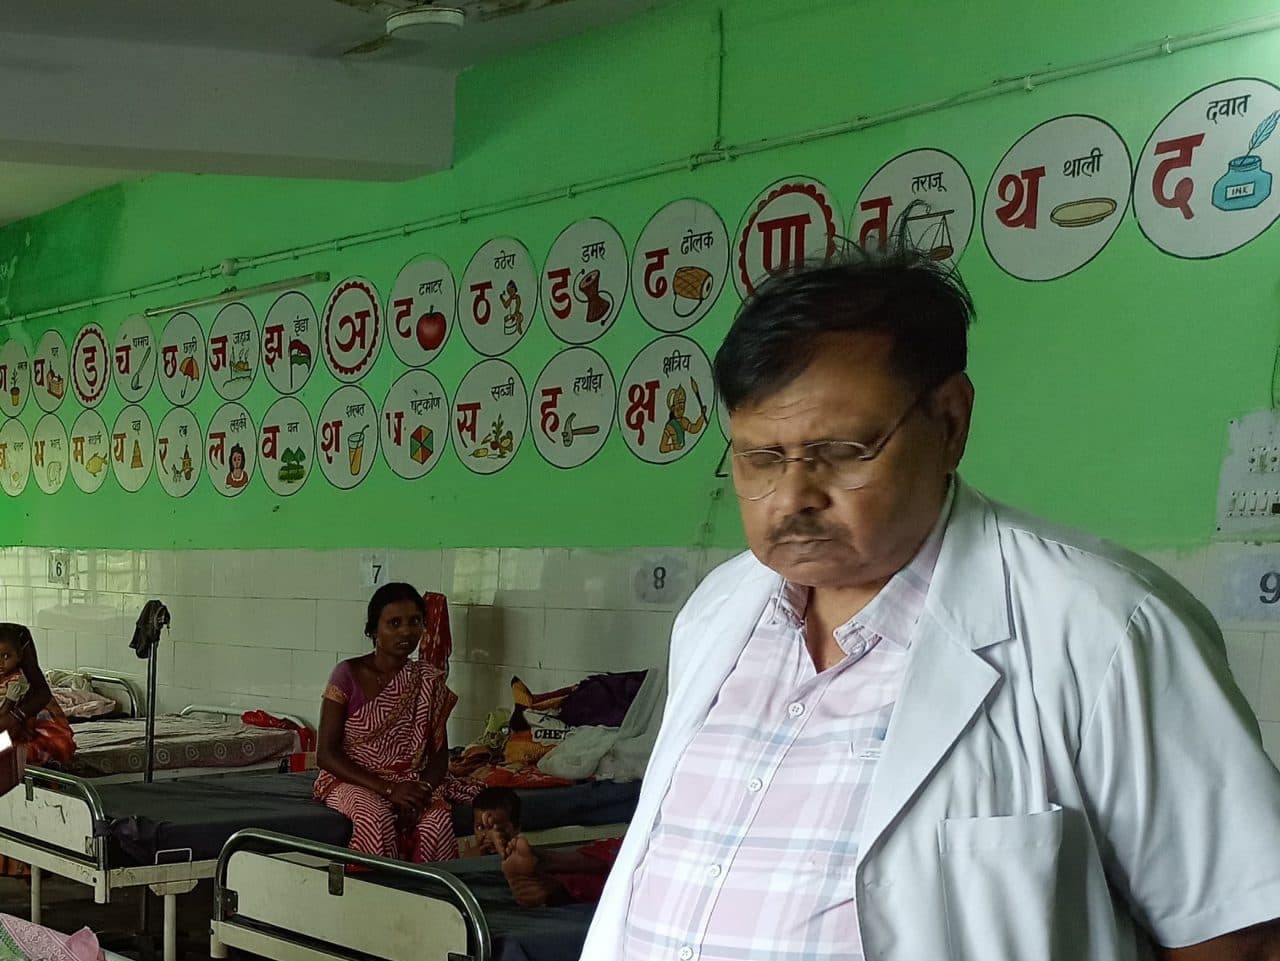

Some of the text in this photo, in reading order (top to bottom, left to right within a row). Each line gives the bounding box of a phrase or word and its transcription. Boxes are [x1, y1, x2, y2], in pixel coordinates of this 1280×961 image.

[1206, 94, 1252, 124] दवात
[1062, 147, 1103, 178] थाली
[1152, 133, 1205, 220] द
[912, 172, 947, 194] तराजू
[995, 166, 1046, 229] थ
[681, 229, 714, 254] ढोलक
[419, 279, 443, 296] टमाटर
[645, 248, 669, 298] ढ
[471, 281, 492, 325] ठ
[548, 268, 571, 319] ड
[394, 298, 413, 338] ट
[115, 345, 131, 374] च
[162, 345, 178, 378] छ
[209, 336, 228, 371] ज
[663, 350, 691, 378] क्षत्रिय
[34, 359, 45, 386] घ
[457, 402, 481, 448] स
[541, 387, 562, 443] ह
[625, 380, 660, 446] क्ष
[72, 437, 85, 465] म
[113, 433, 126, 463] य
[159, 438, 169, 475] र
[209, 432, 226, 470] ल
[262, 425, 280, 460] व
[321, 420, 343, 464] श
[55, 562, 62, 577] 6
[371, 565, 382, 583] 7
[652, 566, 666, 589] 8
[1259, 572, 1280, 604] 9
